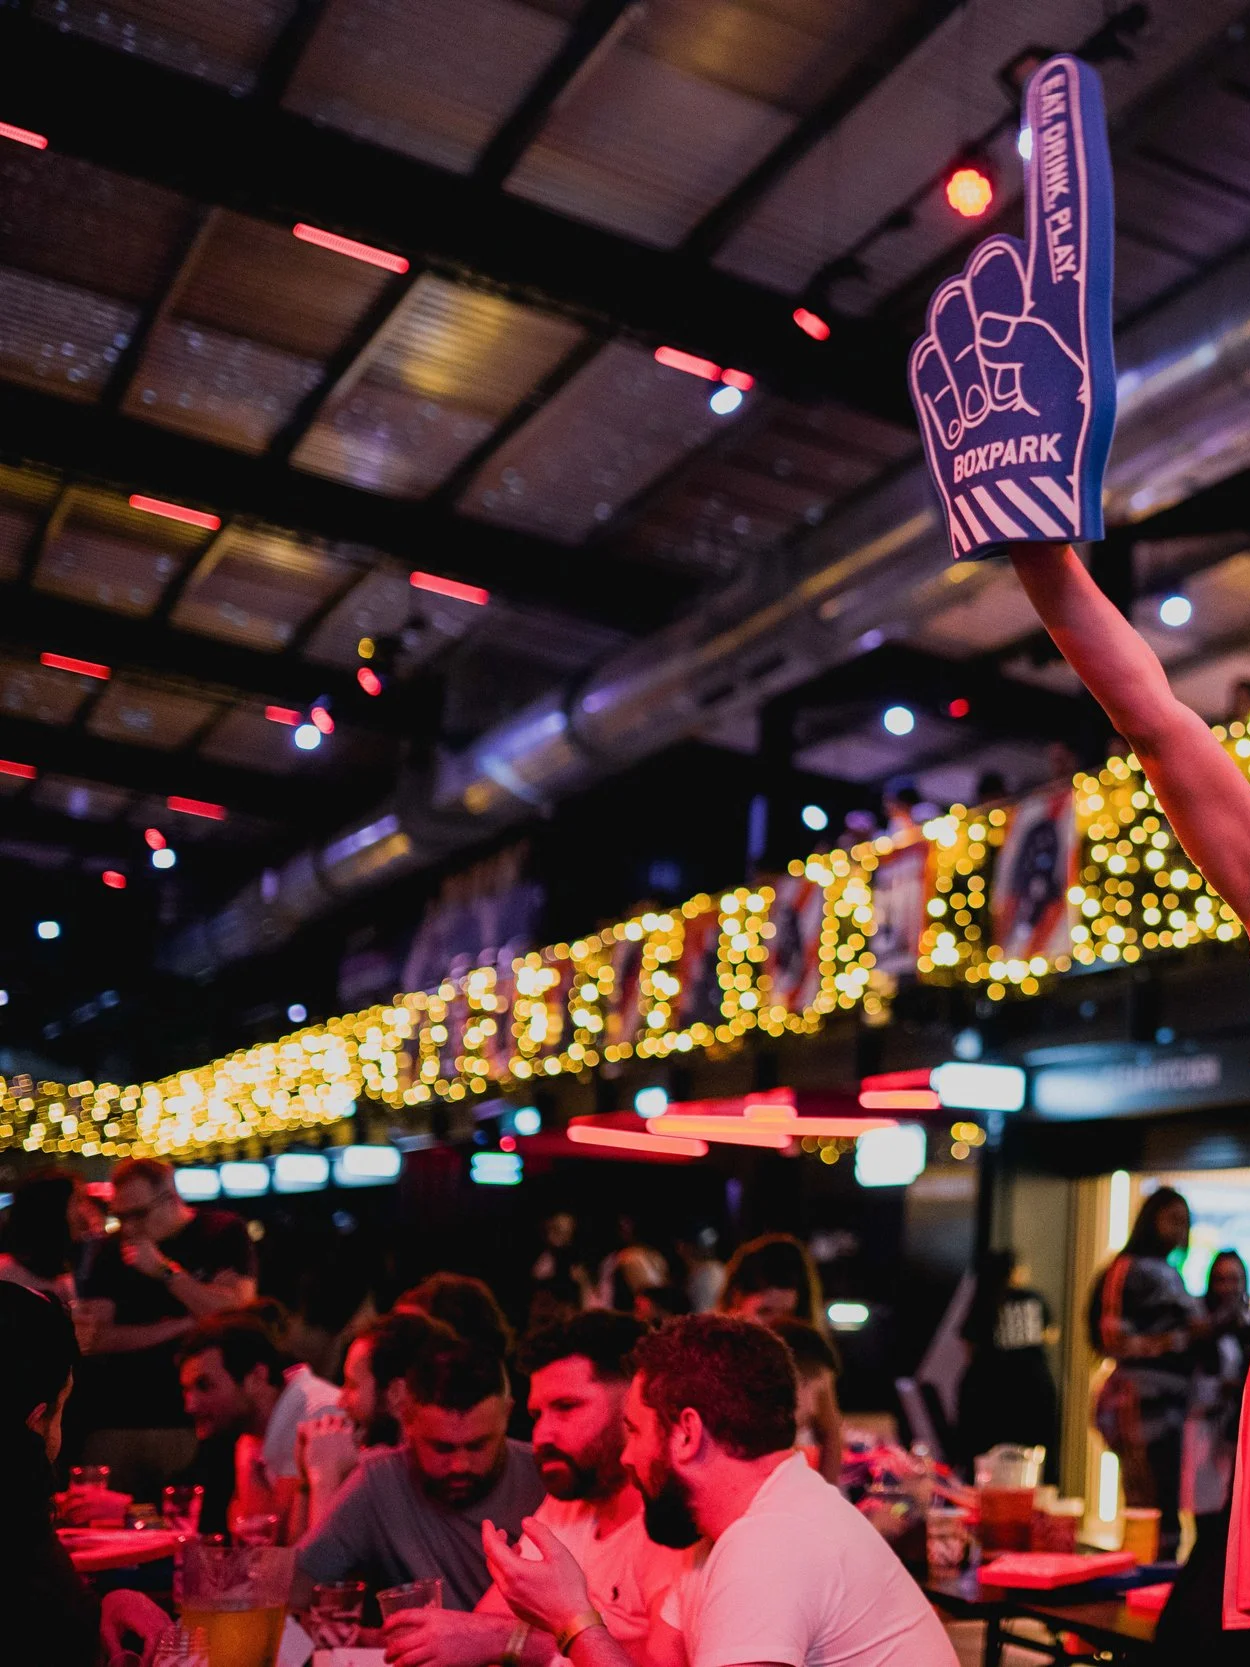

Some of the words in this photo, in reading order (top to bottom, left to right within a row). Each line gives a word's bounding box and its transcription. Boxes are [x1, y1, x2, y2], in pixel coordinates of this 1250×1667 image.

[1042, 120, 1071, 210] DRINK.
[1050, 205, 1078, 283] PLAY.
[953, 432, 1062, 484] BOXPARK
